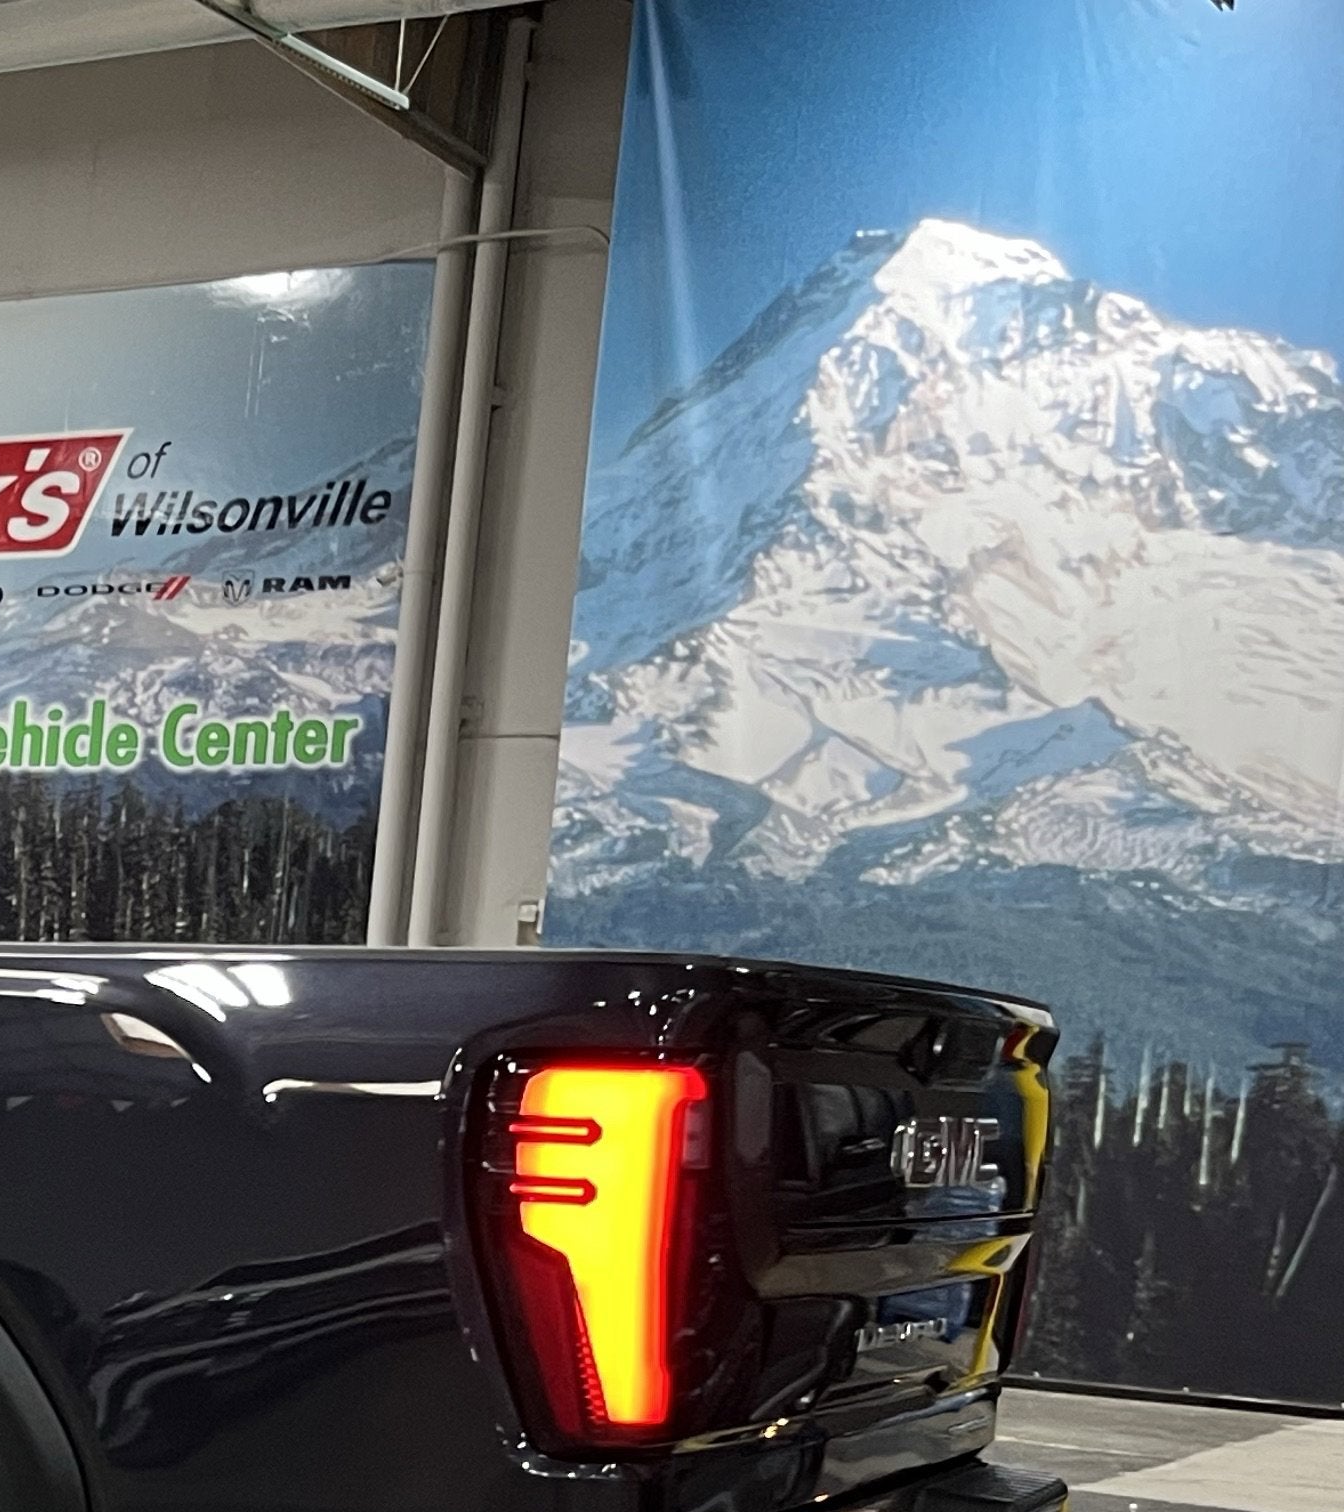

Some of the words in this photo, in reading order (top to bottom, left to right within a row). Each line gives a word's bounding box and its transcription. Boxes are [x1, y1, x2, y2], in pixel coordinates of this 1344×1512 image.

[126, 441, 172, 479] of
[111, 479, 392, 537] Wilsonville
[37, 581, 165, 598] DODGE
[262, 575, 351, 593] RAM
[162, 703, 360, 767] Center
